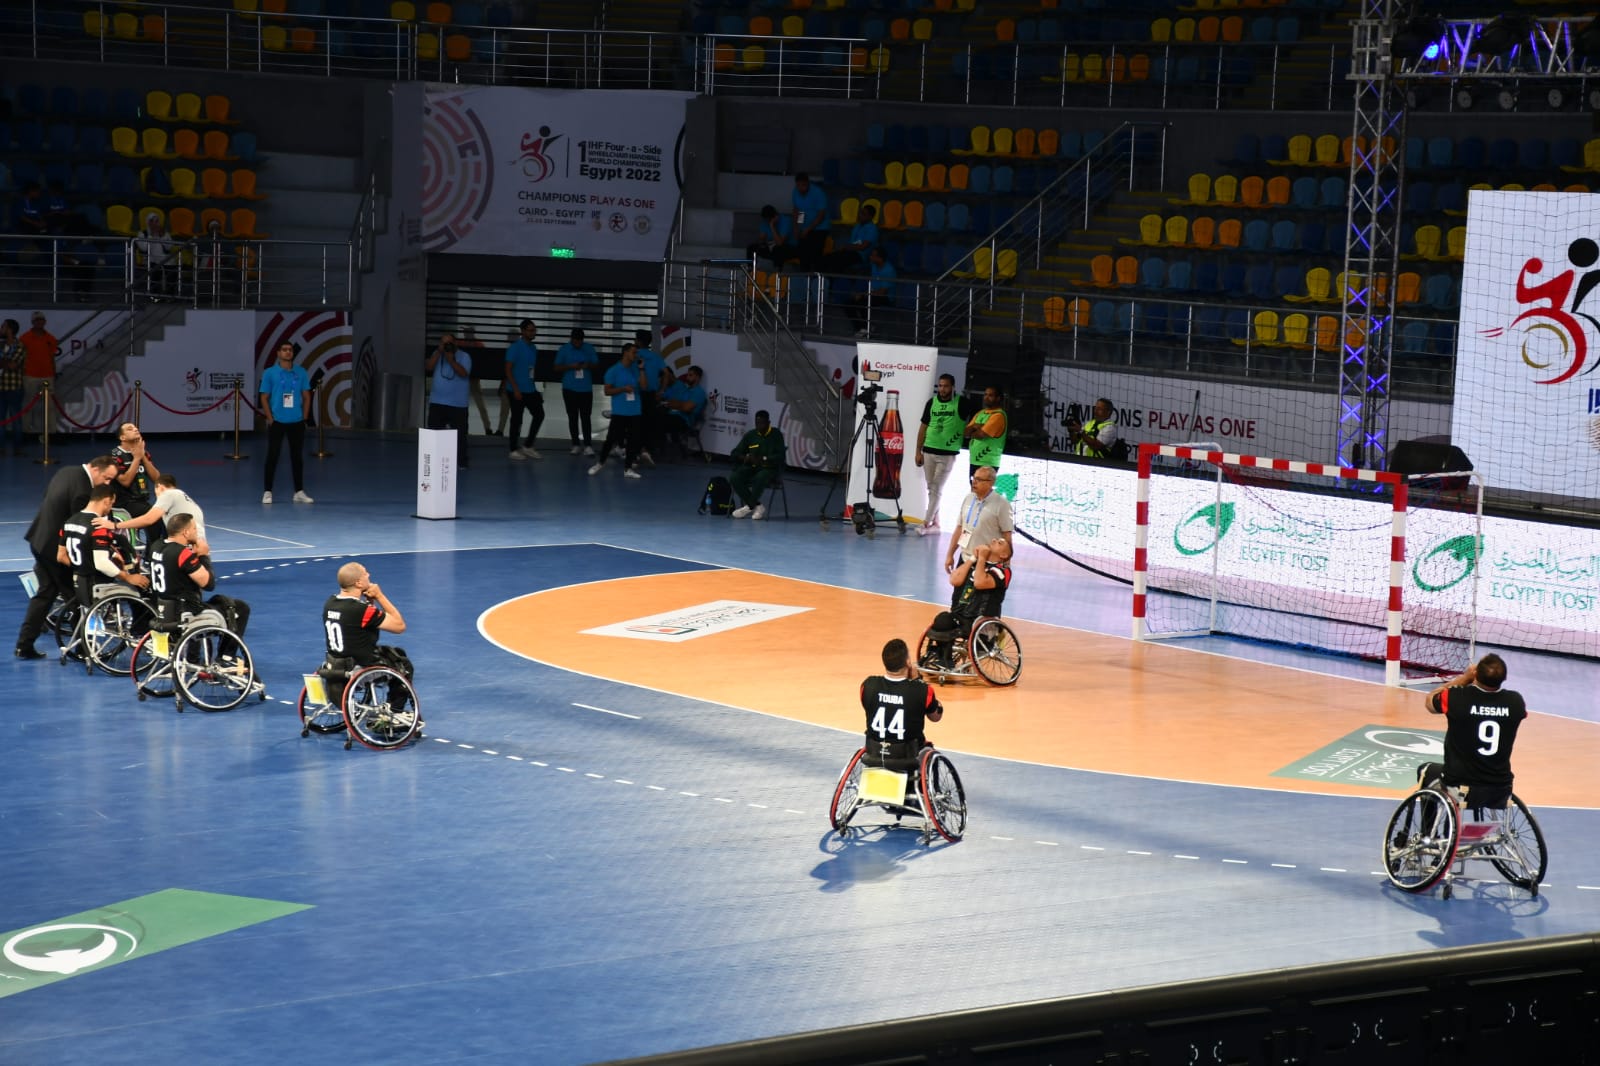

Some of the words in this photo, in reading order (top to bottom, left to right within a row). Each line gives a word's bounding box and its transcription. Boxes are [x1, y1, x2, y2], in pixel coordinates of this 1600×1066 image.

[588, 141, 605, 150] IHF
[605, 142, 626, 152] Four
[643, 145, 662, 155] Side
[579, 164, 622, 181] Egypt
[626, 168, 661, 182] 2022
[518, 191, 587, 204] CHAMPIONS
[590, 195, 616, 206] PLAY
[618, 198, 632, 208] AS
[633, 199, 656, 209] ONE
[518, 207, 548, 217] CAIRO
[556, 209, 586, 219] EGYPT
[875, 361, 913, 371] Coca-Cola
[913, 363, 931, 372] HBC
[879, 370, 895, 379] gypt
[1149, 411, 1190, 432] PLAY
[1193, 415, 1215, 434] AS
[1219, 418, 1256, 438] ONE
[1491, 581, 1547, 604] EGYPT
[1553, 590, 1597, 612] POST
[325, 620, 344, 652] 10
[878, 693, 904, 705] TOUBA
[1470, 705, 1510, 717] A.ESSAM
[871, 706, 906, 740] 44
[1477, 720, 1501, 756] 9
